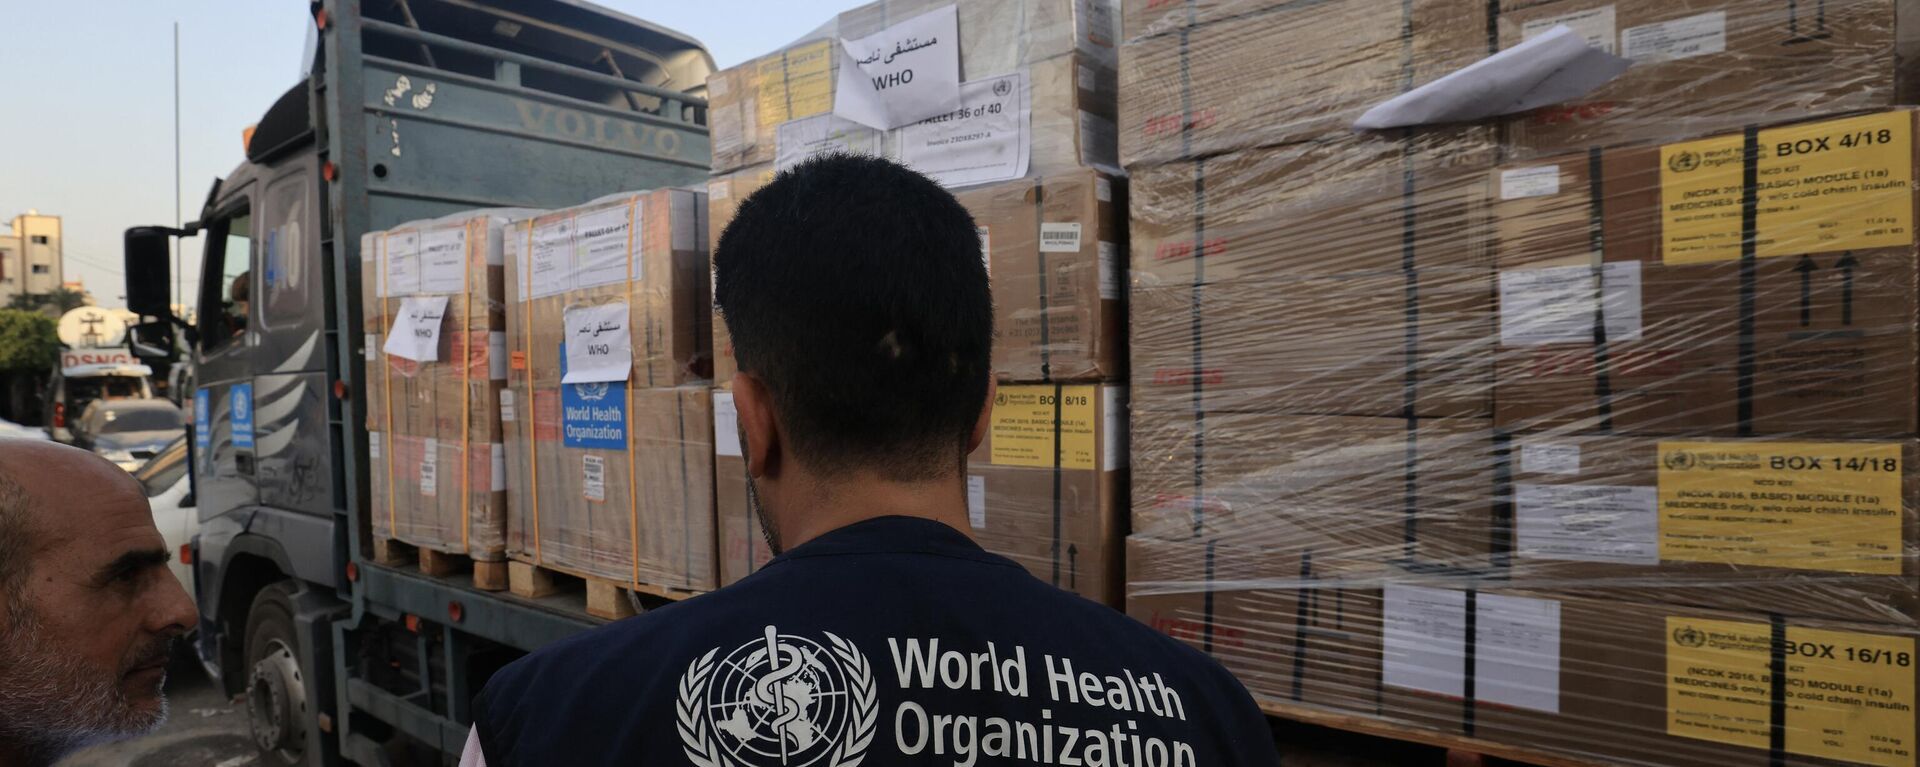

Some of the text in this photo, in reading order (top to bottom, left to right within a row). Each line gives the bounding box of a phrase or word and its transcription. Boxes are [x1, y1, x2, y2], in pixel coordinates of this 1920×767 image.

[883, 36, 938, 64] مستشفى
[872, 69, 913, 91] WHO
[958, 108, 971, 119] 36
[974, 105, 984, 117] of
[987, 103, 1002, 114] 40
[514, 101, 681, 155] VOLVO
[1776, 136, 1830, 157] BOX
[1839, 129, 1892, 148] 4/18
[1803, 171, 1860, 185] MODULE
[1669, 197, 1734, 213] MEDICINES
[1793, 187, 1820, 200] cold
[1823, 184, 1858, 196] chain
[1861, 179, 1906, 192] insulin
[587, 343, 609, 355] WHO
[1039, 395, 1087, 406] BO 8/18
[566, 406, 621, 422] World Health
[566, 424, 622, 443] Organization
[1770, 456, 1897, 472] BOX 14/18
[1665, 501, 1728, 511] MEDICINES
[1787, 505, 1813, 514] cold
[1815, 505, 1849, 516] chain
[1852, 507, 1897, 518] insulin
[1750, 492, 1793, 502] BASIC)
[1796, 494, 1851, 504] MODULE
[1855, 495, 1881, 505] (1a)
[1783, 640, 1911, 667] BOX 16/18
[887, 637, 1187, 721] World Health
[1687, 666, 1725, 678] (NCDK
[1808, 680, 1864, 695] MODULE
[1868, 687, 1894, 698] (1a)
[1674, 677, 1738, 692] MEDICINES
[1797, 692, 1824, 702] cold
[1827, 694, 1863, 706] chain
[1865, 698, 1910, 712] insulin
[894, 701, 1197, 767] Organization
